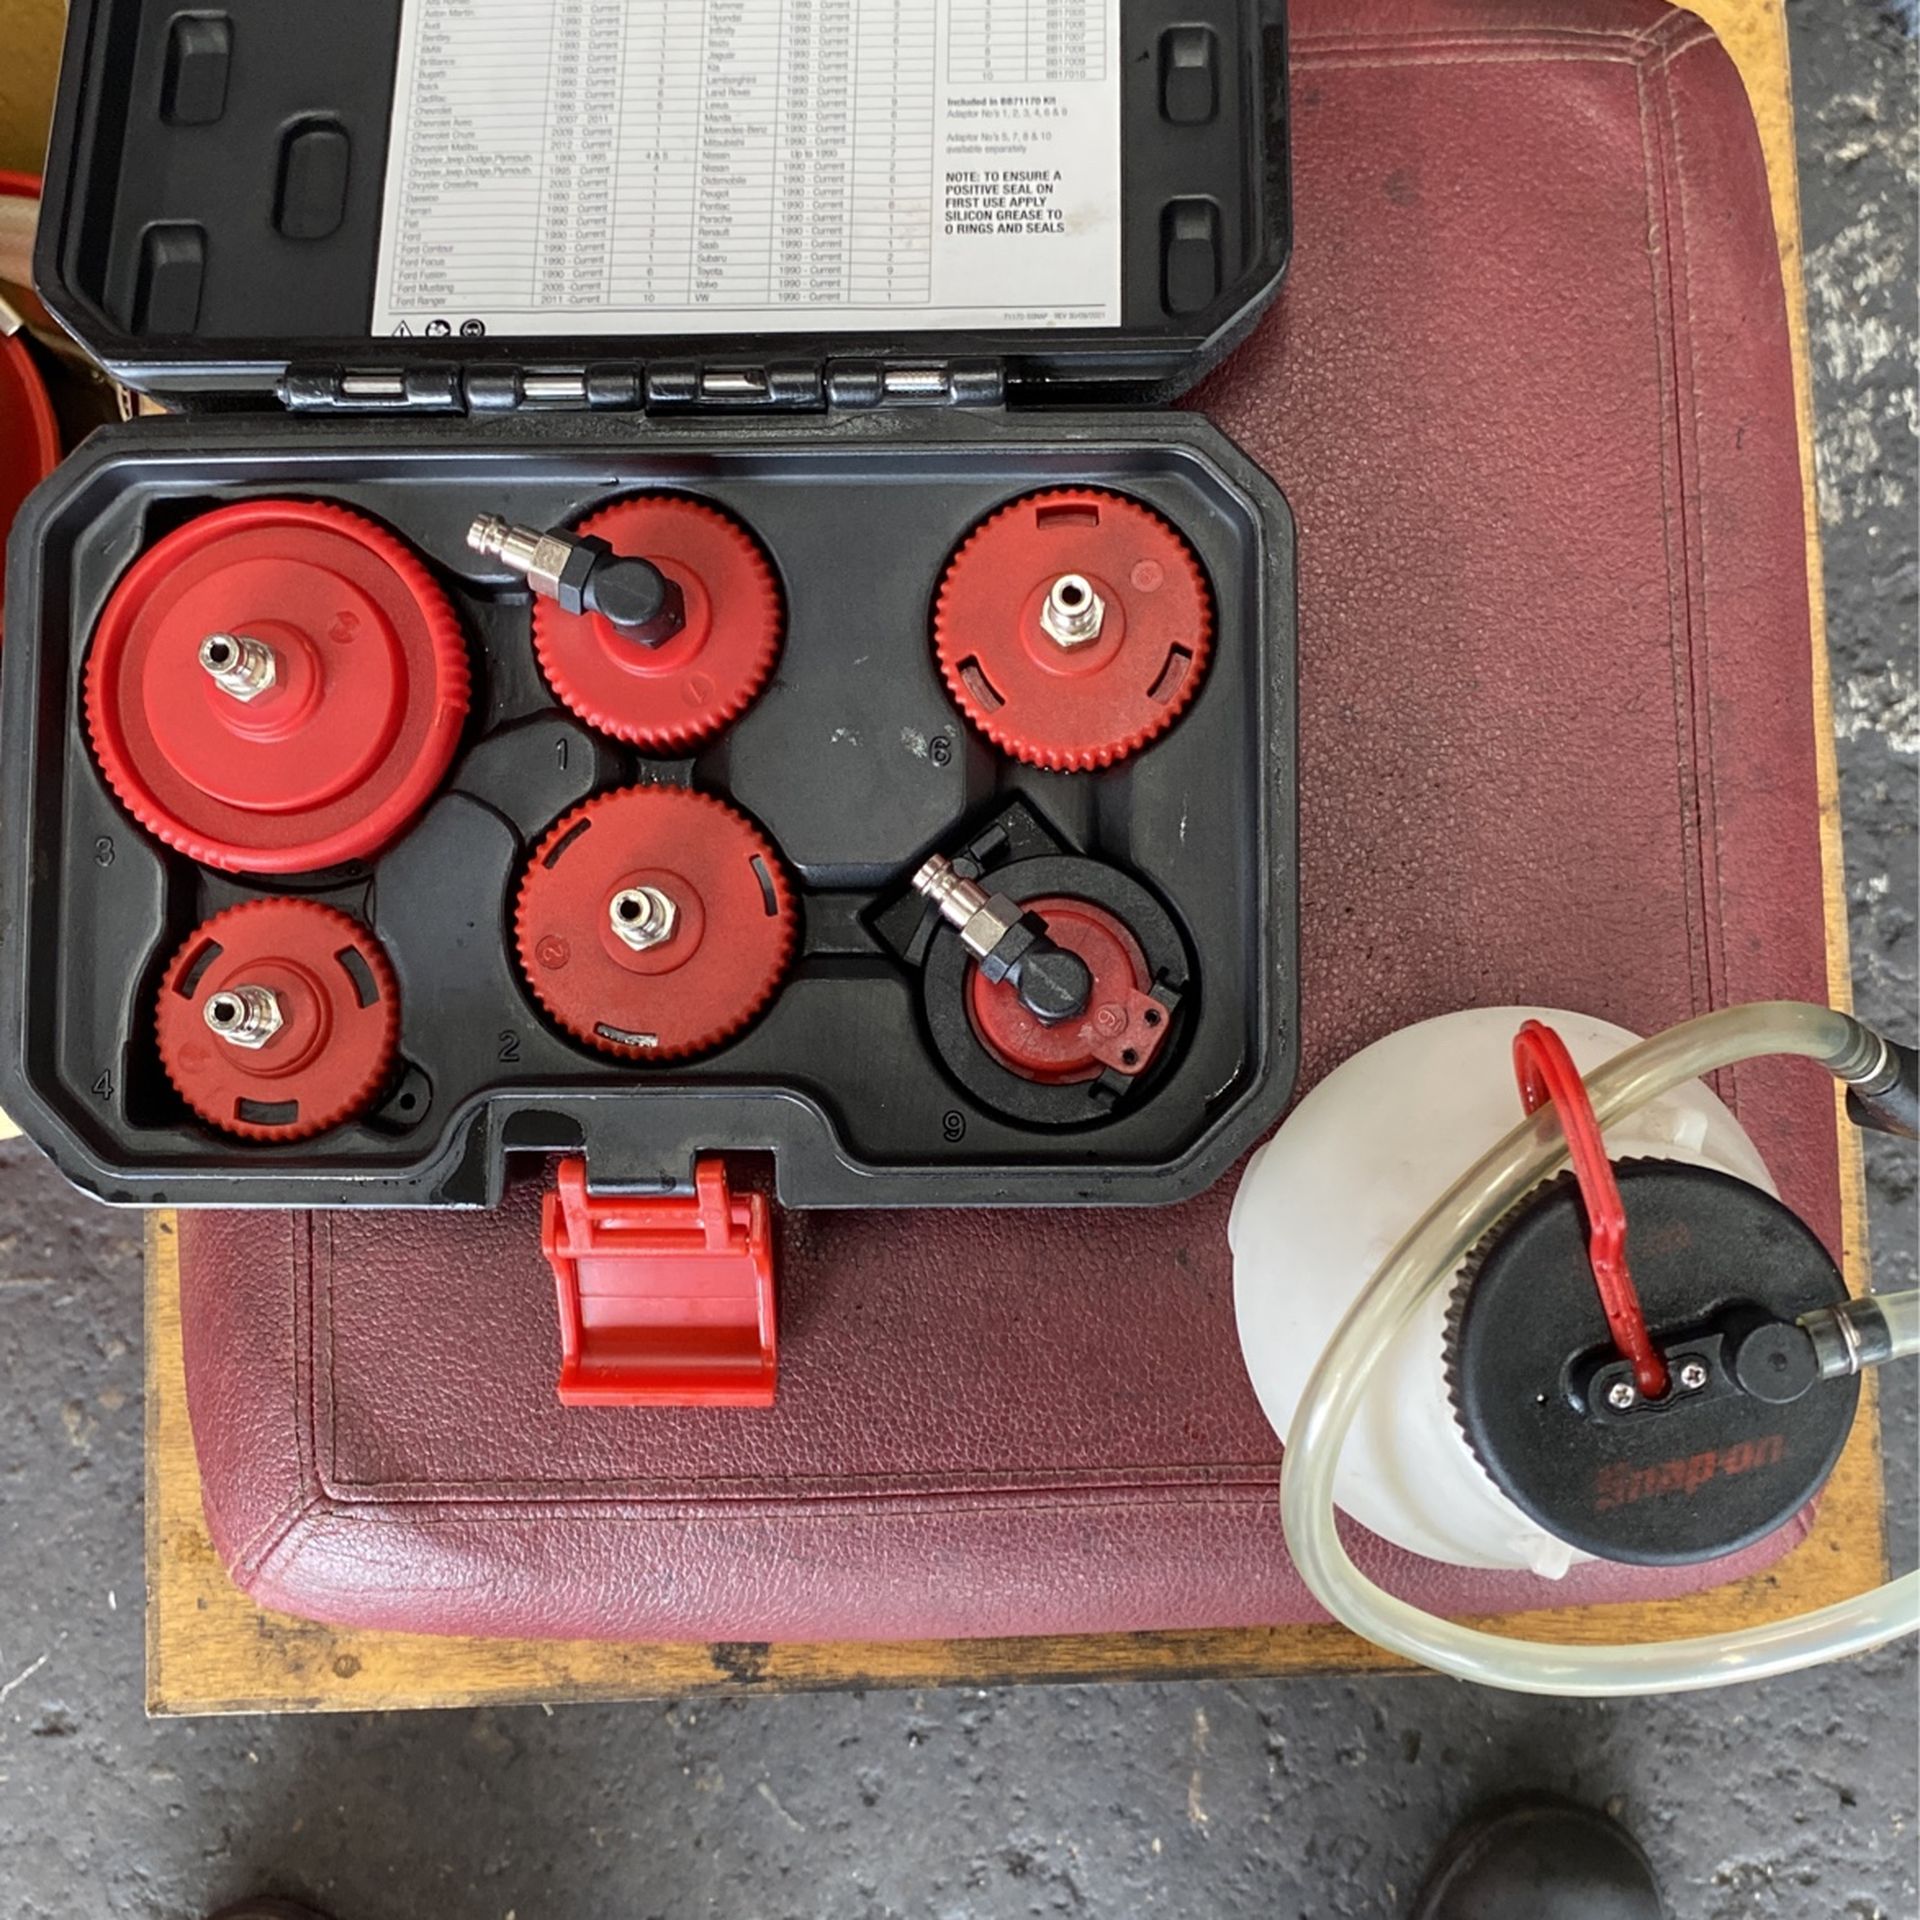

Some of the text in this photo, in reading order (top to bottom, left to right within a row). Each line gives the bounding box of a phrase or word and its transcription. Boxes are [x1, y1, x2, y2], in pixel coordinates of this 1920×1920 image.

[946, 170, 1062, 182] NOTE: TO ENSURE A
[946, 183, 1054, 195] POSITIVE SEAL ON
[945, 197, 1047, 208] FIRST USE APPLY
[945, 209, 1062, 221] SILICON GREASE TO
[945, 222, 1065, 235] O RINGS AND SEALS
[643, 293, 655, 302] 10
[555, 738, 568, 770] 1
[929, 735, 952, 767] 6
[94, 837, 115, 866] 3
[498, 1030, 521, 1062] 2
[91, 1069, 114, 1100] 4
[943, 1111, 966, 1142] 9
